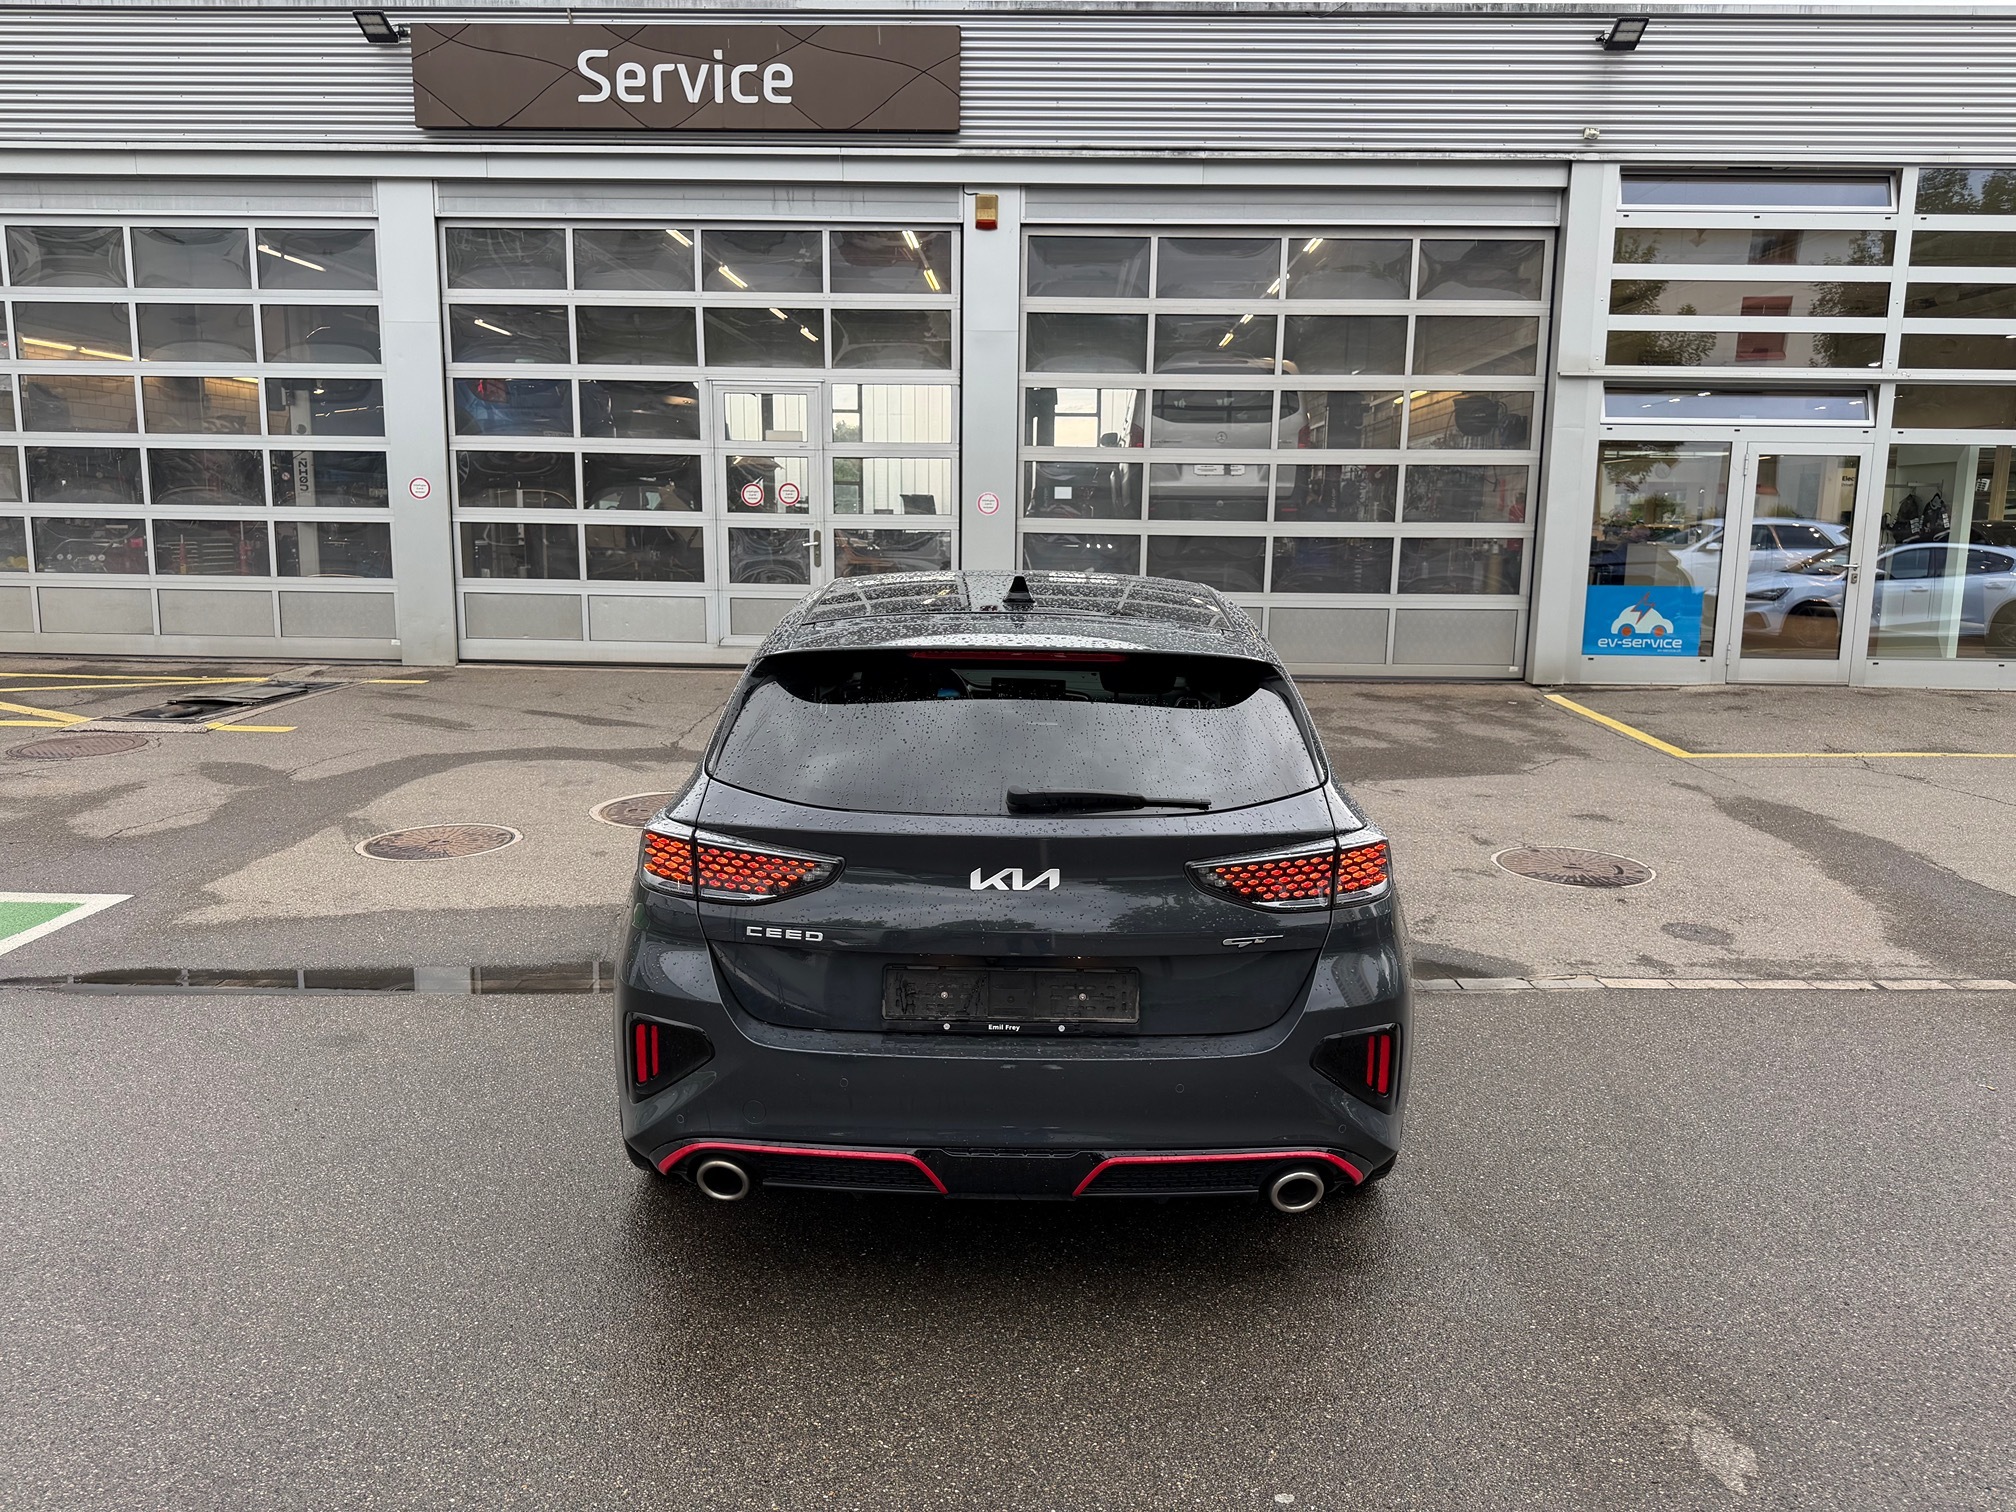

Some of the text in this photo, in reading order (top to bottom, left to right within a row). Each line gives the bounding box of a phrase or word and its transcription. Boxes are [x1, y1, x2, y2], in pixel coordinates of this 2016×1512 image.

[577, 49, 794, 104] Service
[1597, 638, 1683, 649] ev-service
[970, 867, 1061, 891] KIA
[746, 925, 824, 942] CEED
[1005, 1024, 1021, 1032] Frey
